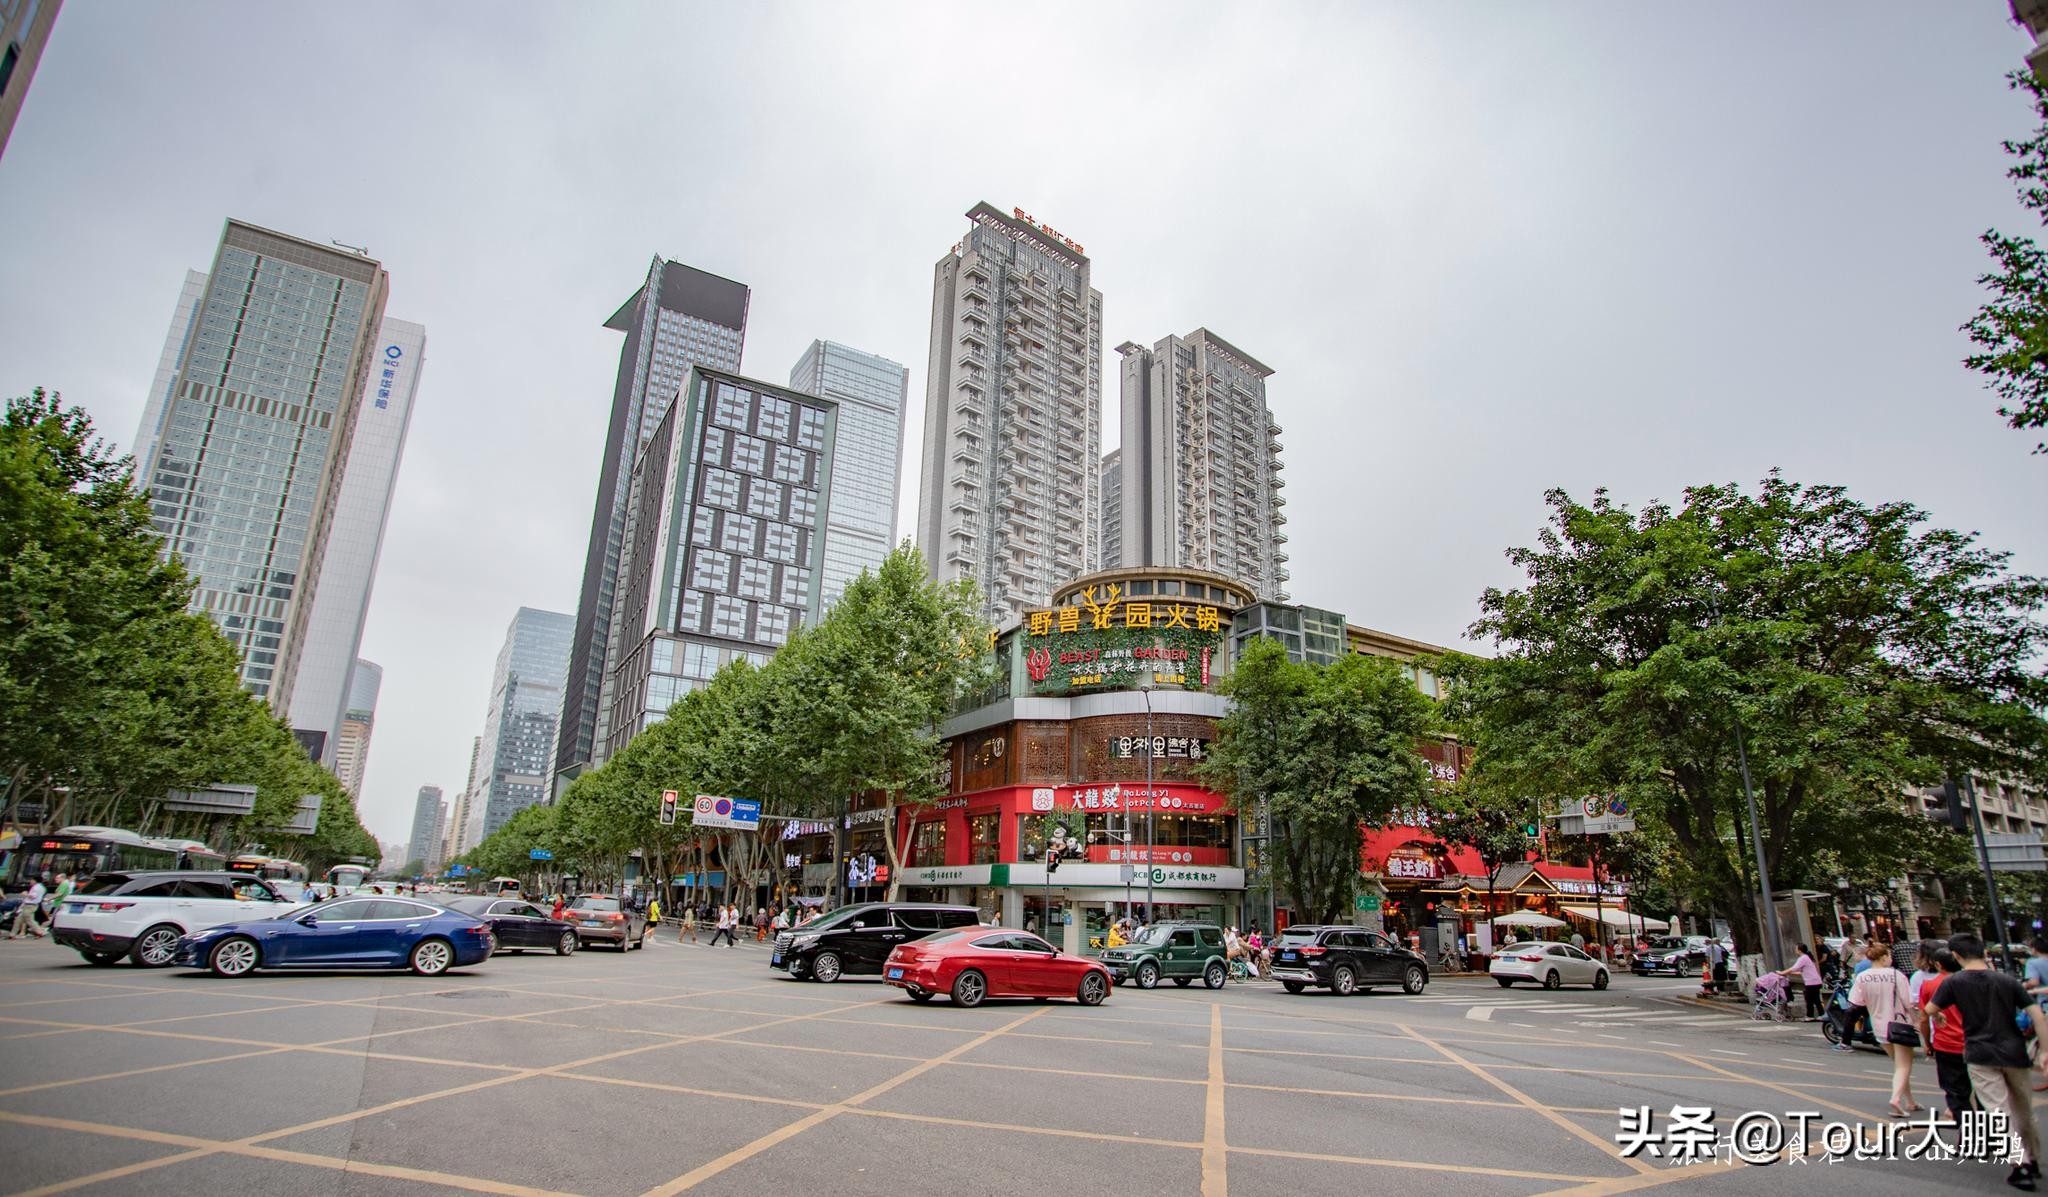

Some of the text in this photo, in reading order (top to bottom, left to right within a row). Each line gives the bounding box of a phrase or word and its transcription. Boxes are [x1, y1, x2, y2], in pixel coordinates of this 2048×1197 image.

[375, 369, 395, 409] 新华保险
[1059, 650, 1101, 665] BEAST
[1133, 646, 1188, 661] GARDEN
[1135, 789, 1158, 798] Log
[700, 801, 711, 810] 60
[1860, 974, 1896, 984] LOEWE
